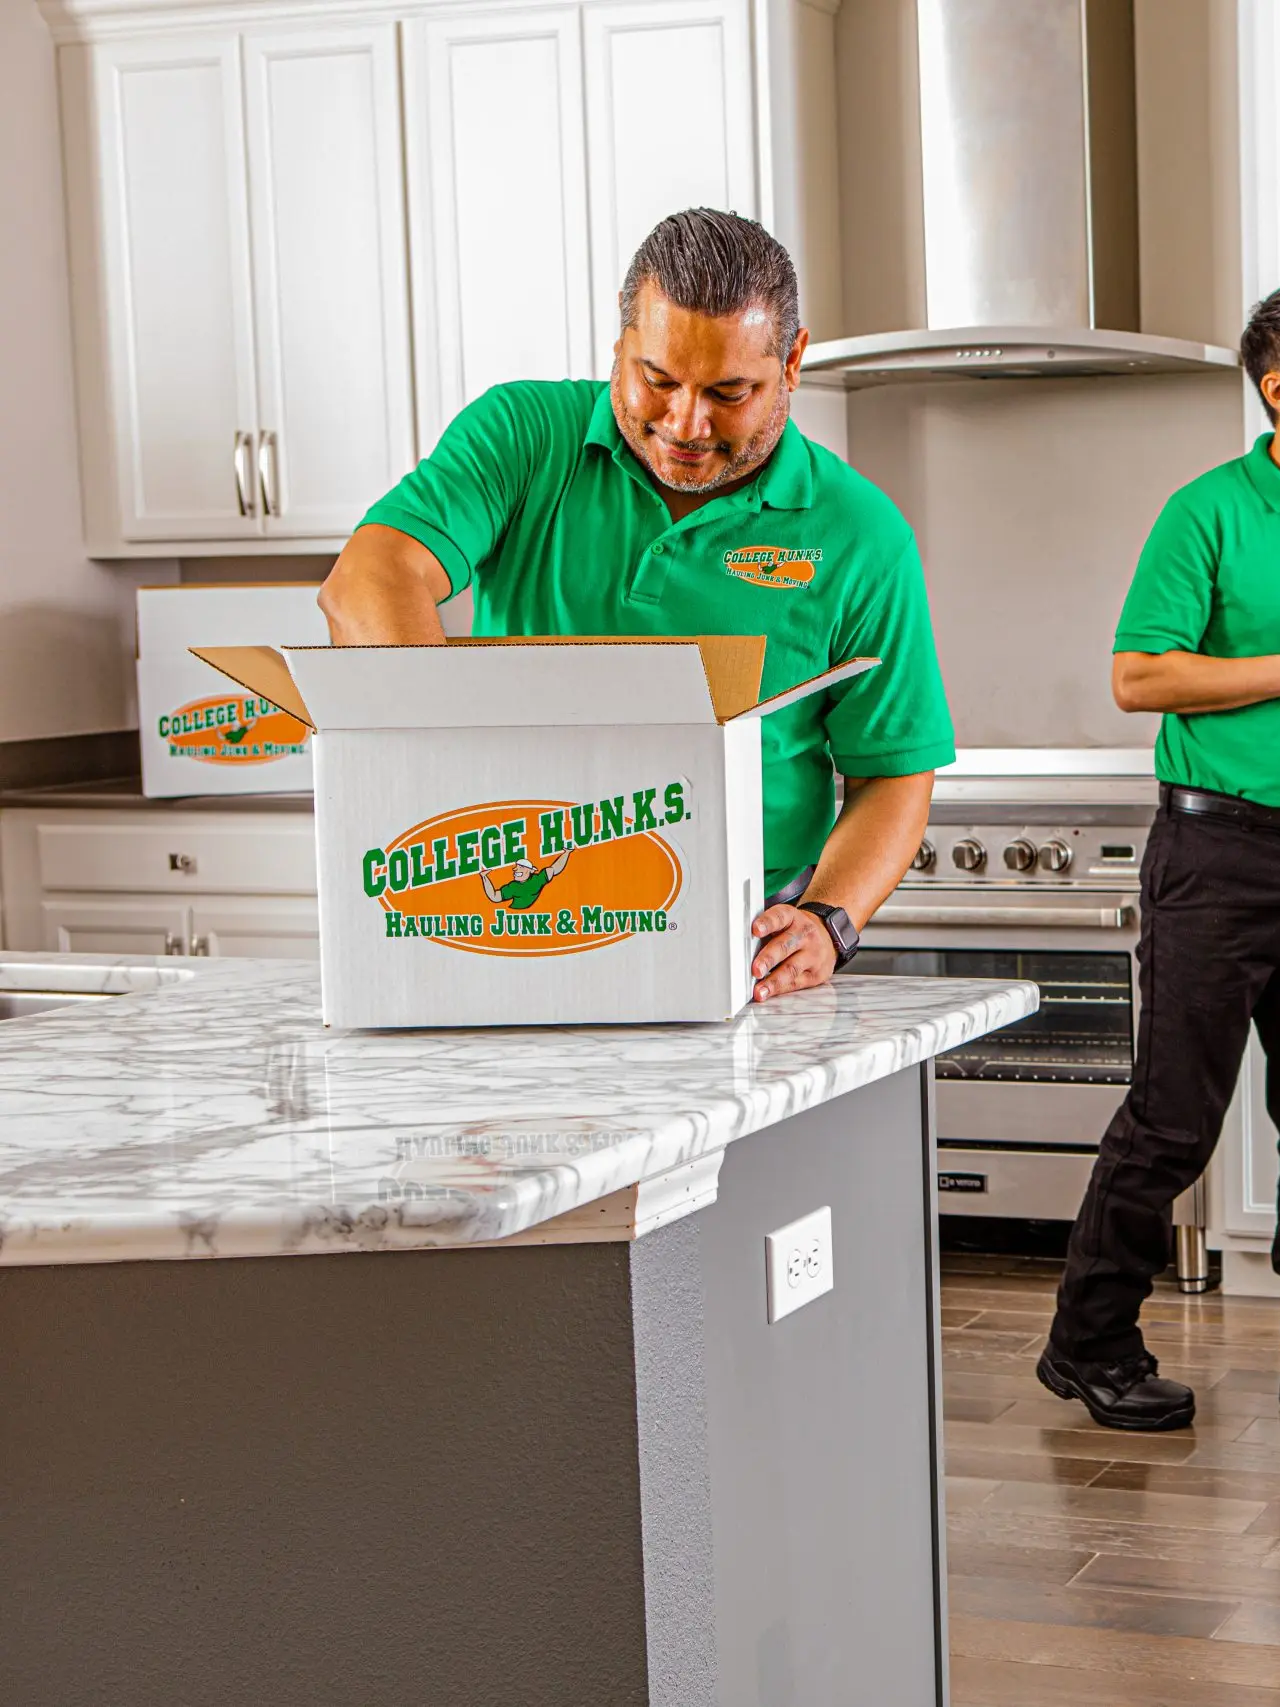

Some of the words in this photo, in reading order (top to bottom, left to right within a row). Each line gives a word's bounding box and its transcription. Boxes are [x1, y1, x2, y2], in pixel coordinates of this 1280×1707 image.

[723, 551, 775, 563] COLLEGE
[159, 703, 237, 738] COLLEGE
[363, 818, 526, 898] COLLEGE
[540, 782, 692, 856] H.U.N.K.S.
[386, 912, 483, 938] HAULING
[491, 910, 551, 936] JUNK
[557, 910, 576, 934] &
